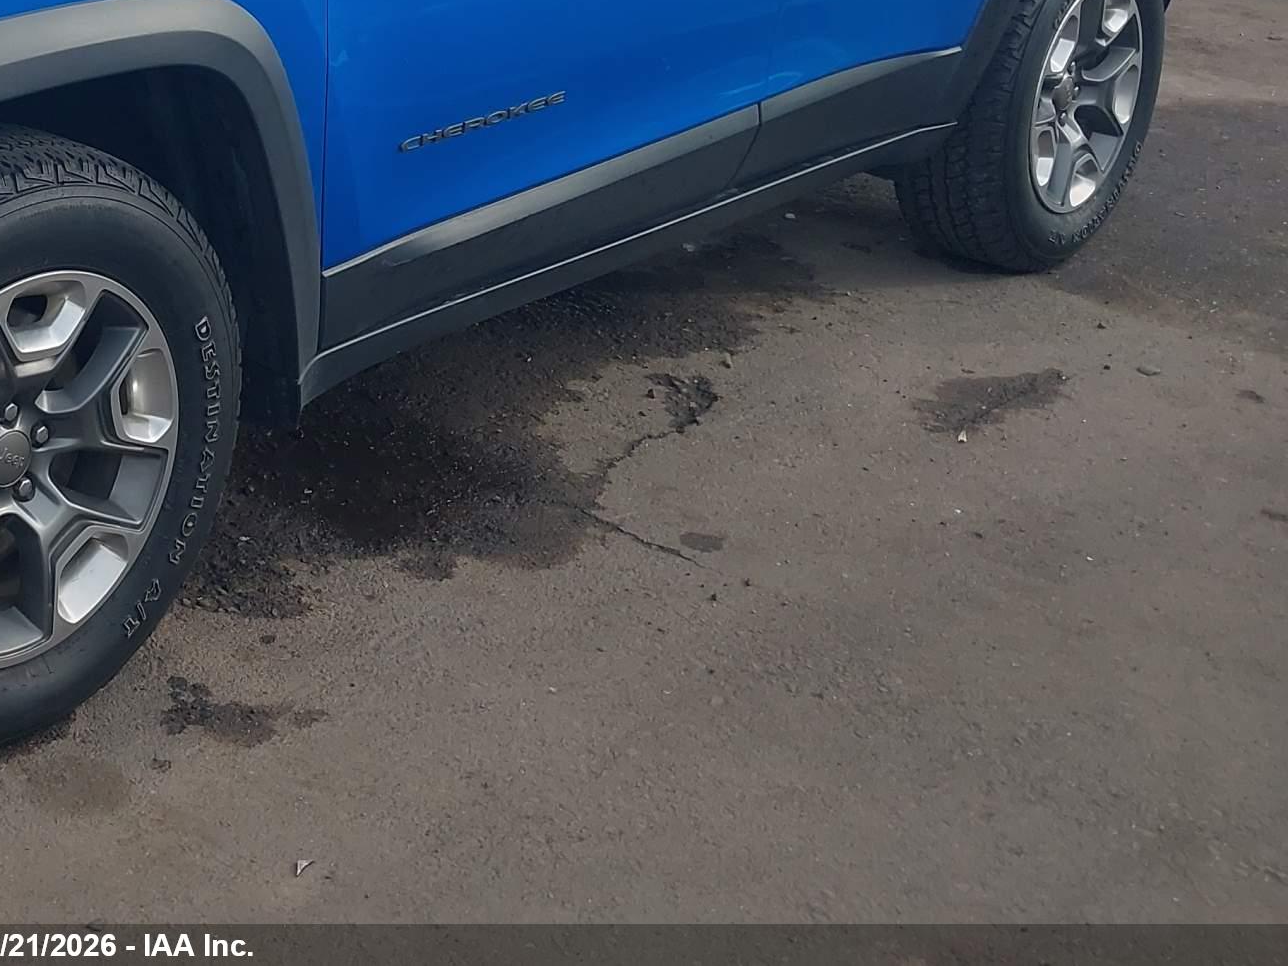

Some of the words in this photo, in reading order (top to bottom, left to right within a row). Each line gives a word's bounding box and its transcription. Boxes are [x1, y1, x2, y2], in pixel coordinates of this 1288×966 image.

[399, 91, 566, 153] CHEROKEE
[168, 316, 220, 565] DESTINATION
[123, 578, 161, 636] A/T
